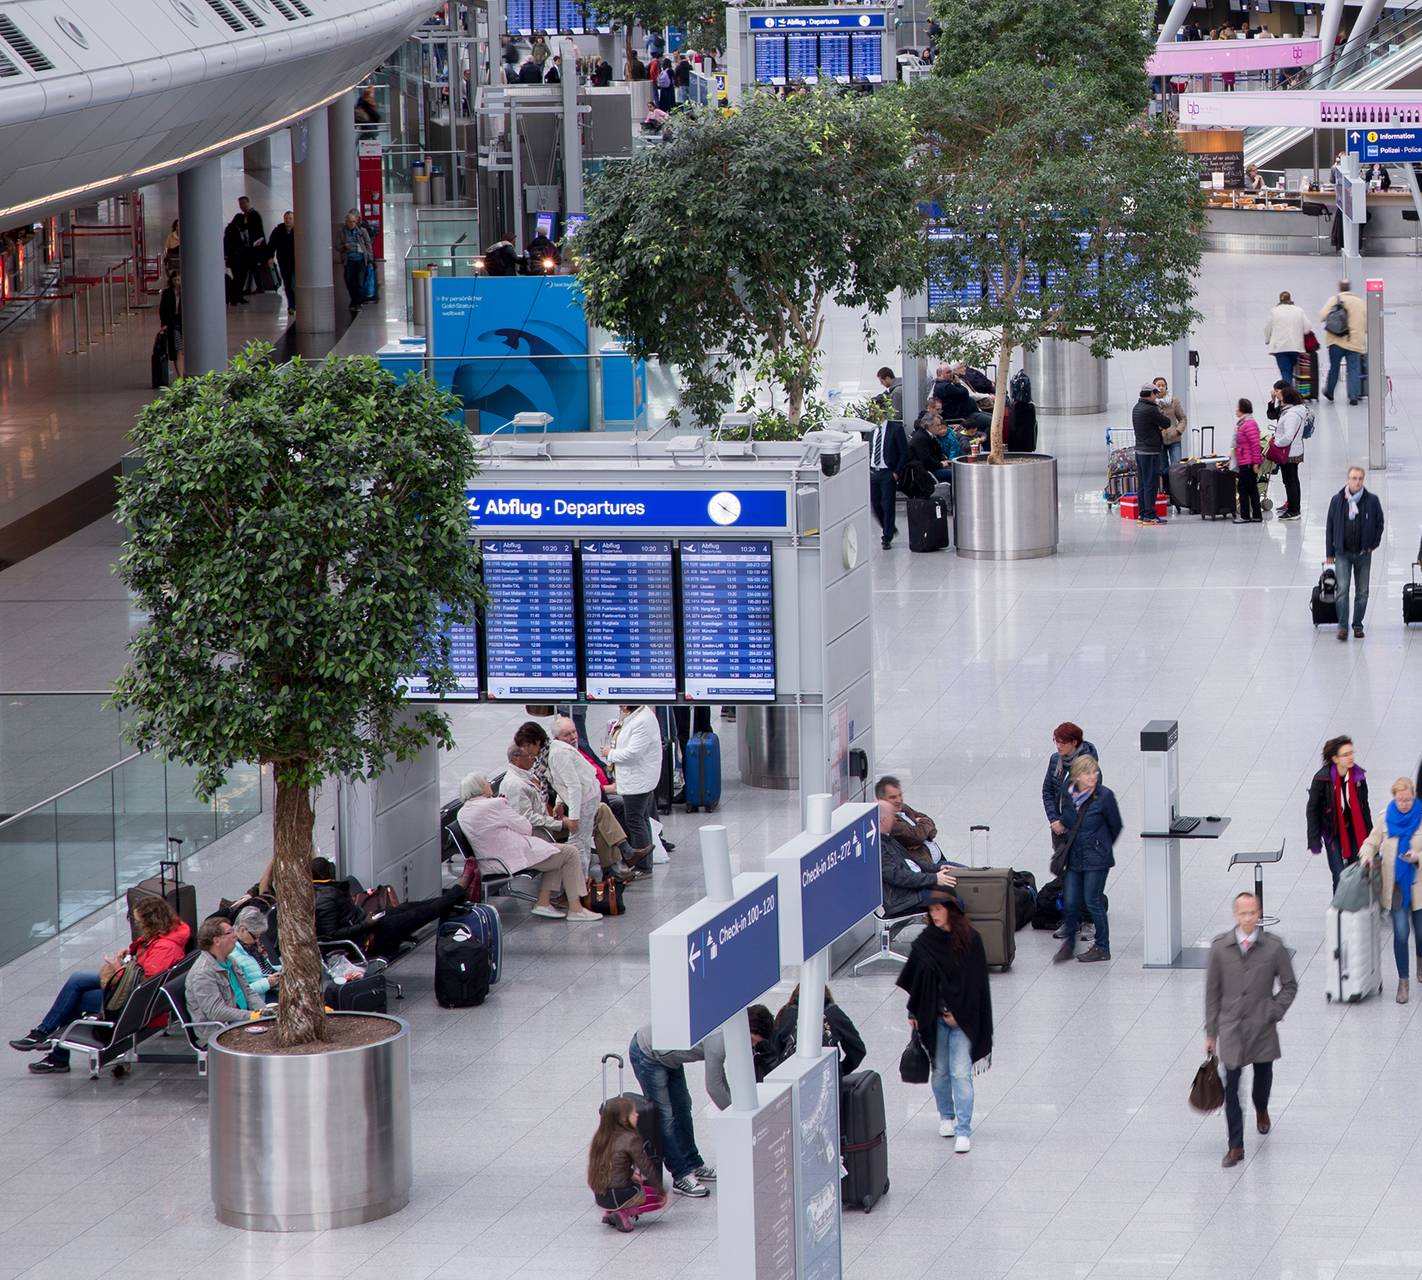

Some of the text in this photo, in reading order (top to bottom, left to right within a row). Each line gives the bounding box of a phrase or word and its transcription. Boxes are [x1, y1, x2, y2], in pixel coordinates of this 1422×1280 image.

[485, 498, 645, 519] Abflug Departures
[503, 542, 522, 550] Abflug
[602, 542, 620, 550] Abflug
[802, 857, 826, 887] Check-in
[718, 914, 747, 944] Check-in
